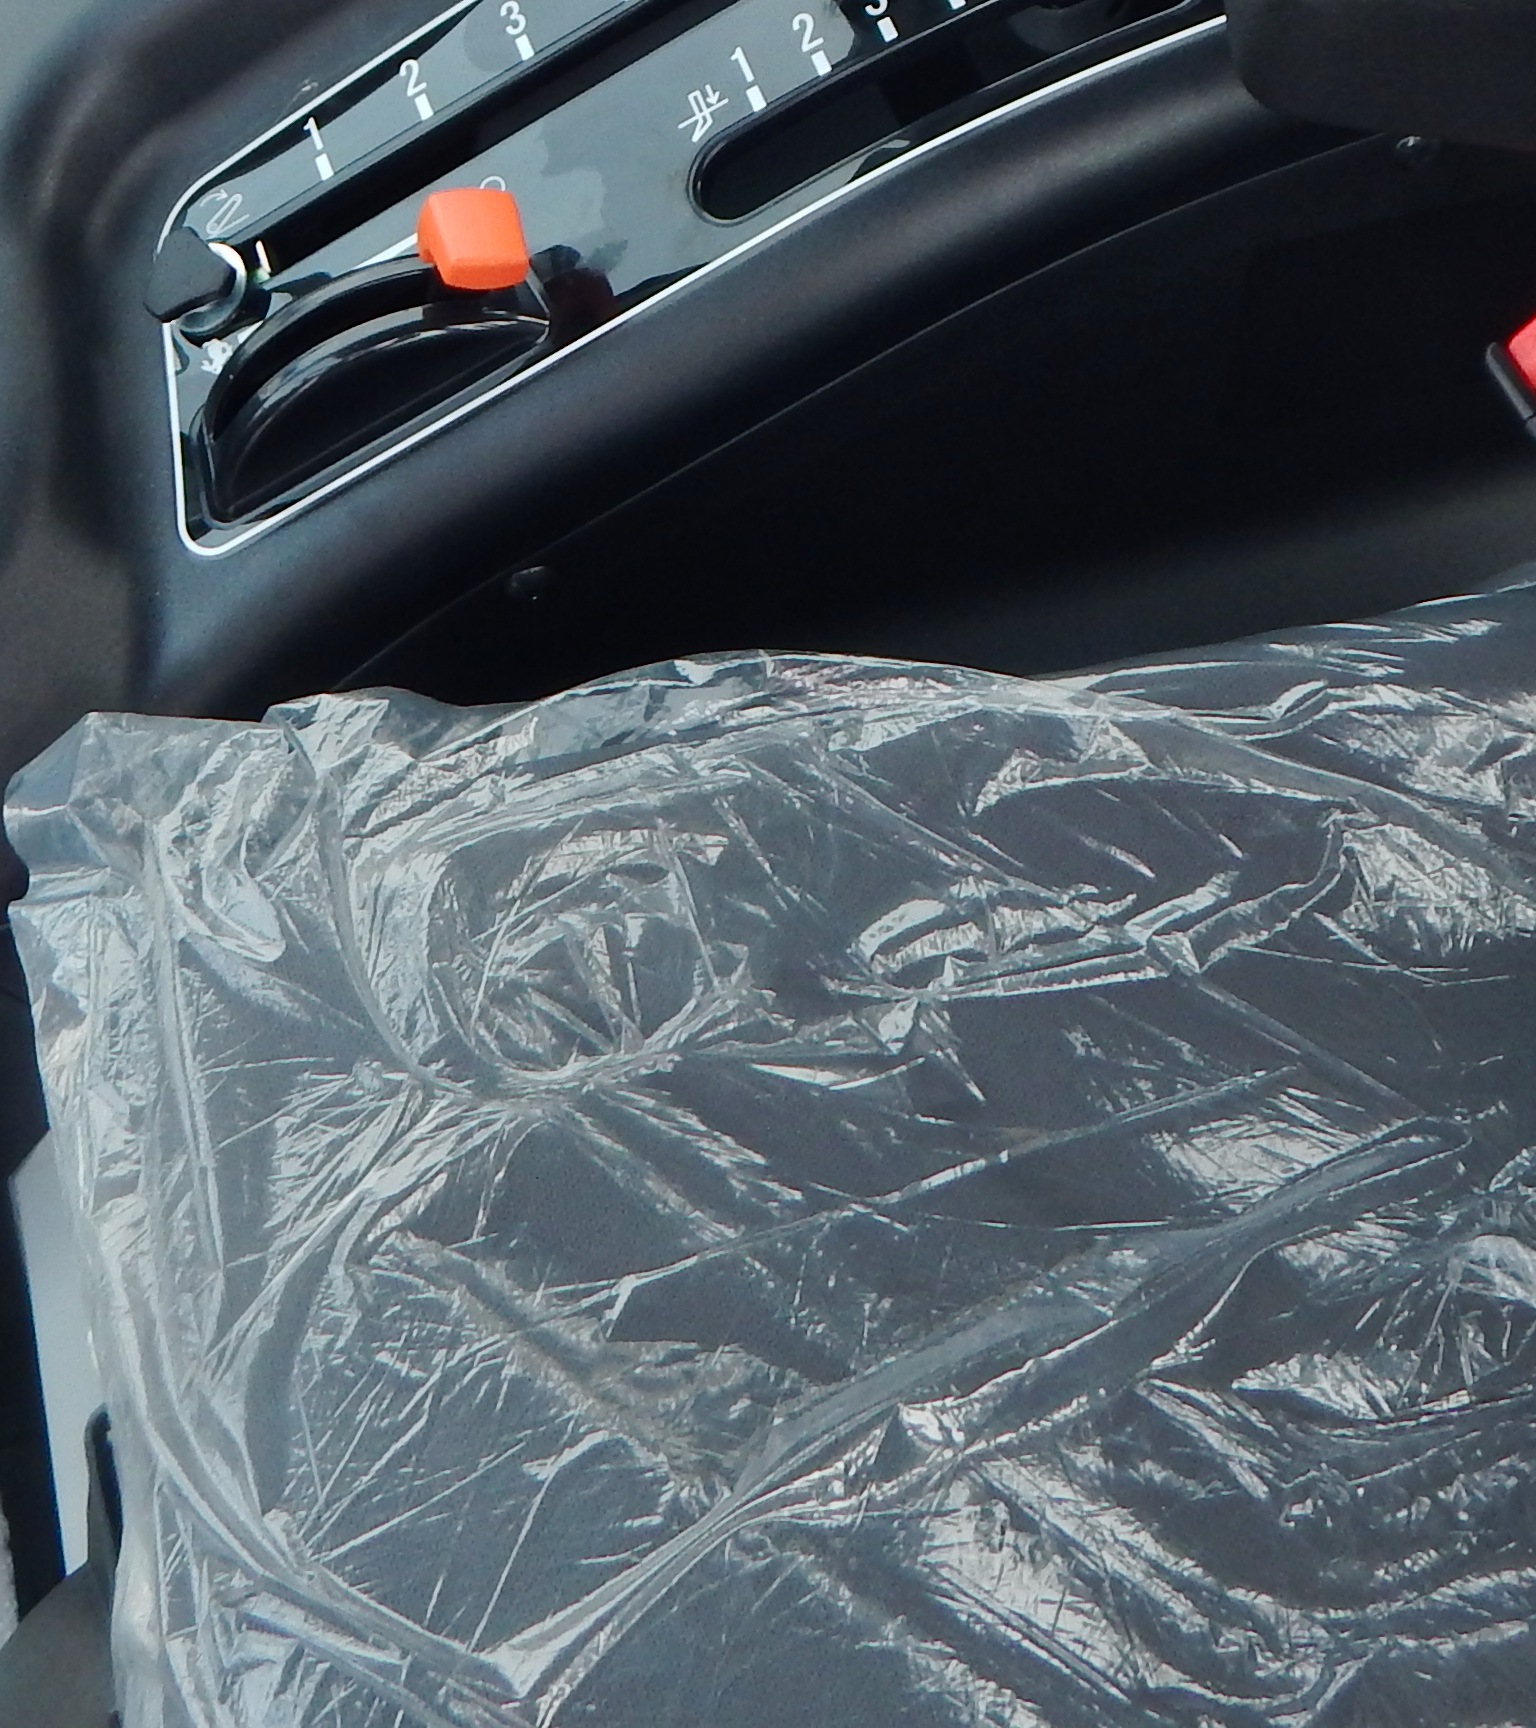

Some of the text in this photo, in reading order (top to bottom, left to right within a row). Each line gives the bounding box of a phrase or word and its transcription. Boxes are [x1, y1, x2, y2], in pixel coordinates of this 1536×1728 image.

[304, 117, 323, 153] 1
[399, 60, 425, 97] 2
[499, 0, 525, 37] 3
[729, 47, 750, 83] 1
[792, 14, 818, 50] 2
